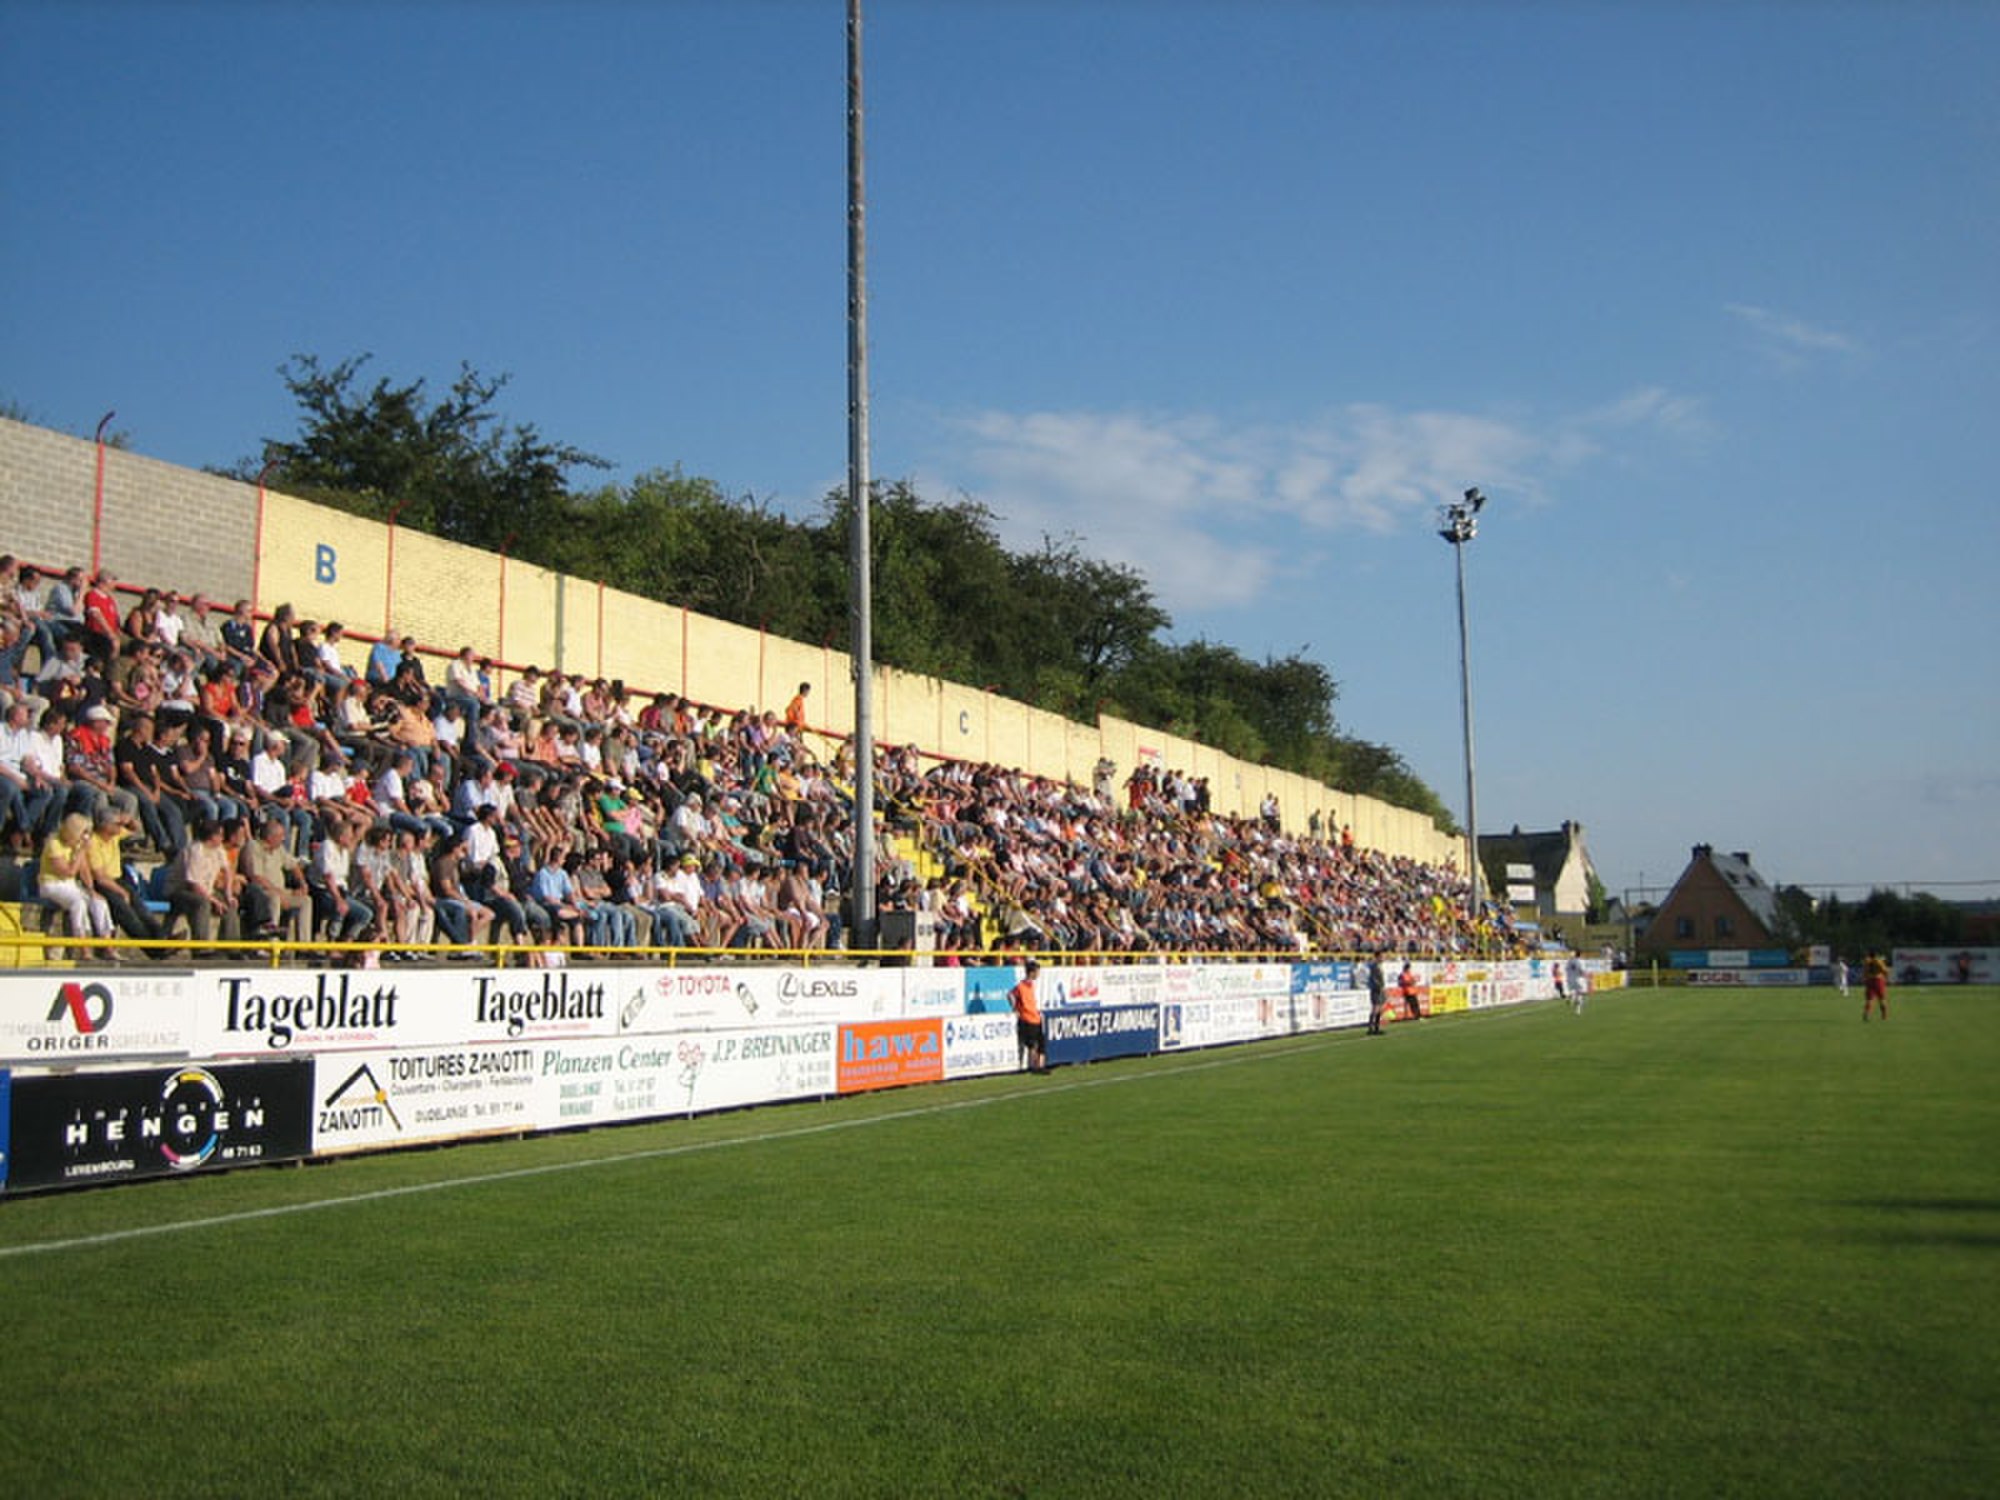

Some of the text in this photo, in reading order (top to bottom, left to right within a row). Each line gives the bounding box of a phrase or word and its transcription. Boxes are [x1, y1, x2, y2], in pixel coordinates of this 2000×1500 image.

[315, 543, 337, 584] B
[960, 710, 969, 735] C
[677, 976, 731, 996] TOYOTA
[801, 980, 858, 997] LEXUS
[219, 973, 398, 1048] Tageblatt
[472, 972, 605, 1036] Tageblatt
[1048, 1012, 1099, 1041] VOYAGES
[27, 1035, 109, 1051] ORIGER
[843, 1030, 939, 1063] hawa
[389, 1049, 534, 1081] TOITURES ZANOTTI
[542, 1044, 672, 1076] Planzen Center
[66, 1108, 264, 1146] HENGEN
[319, 1106, 384, 1133] ZANOTTI
